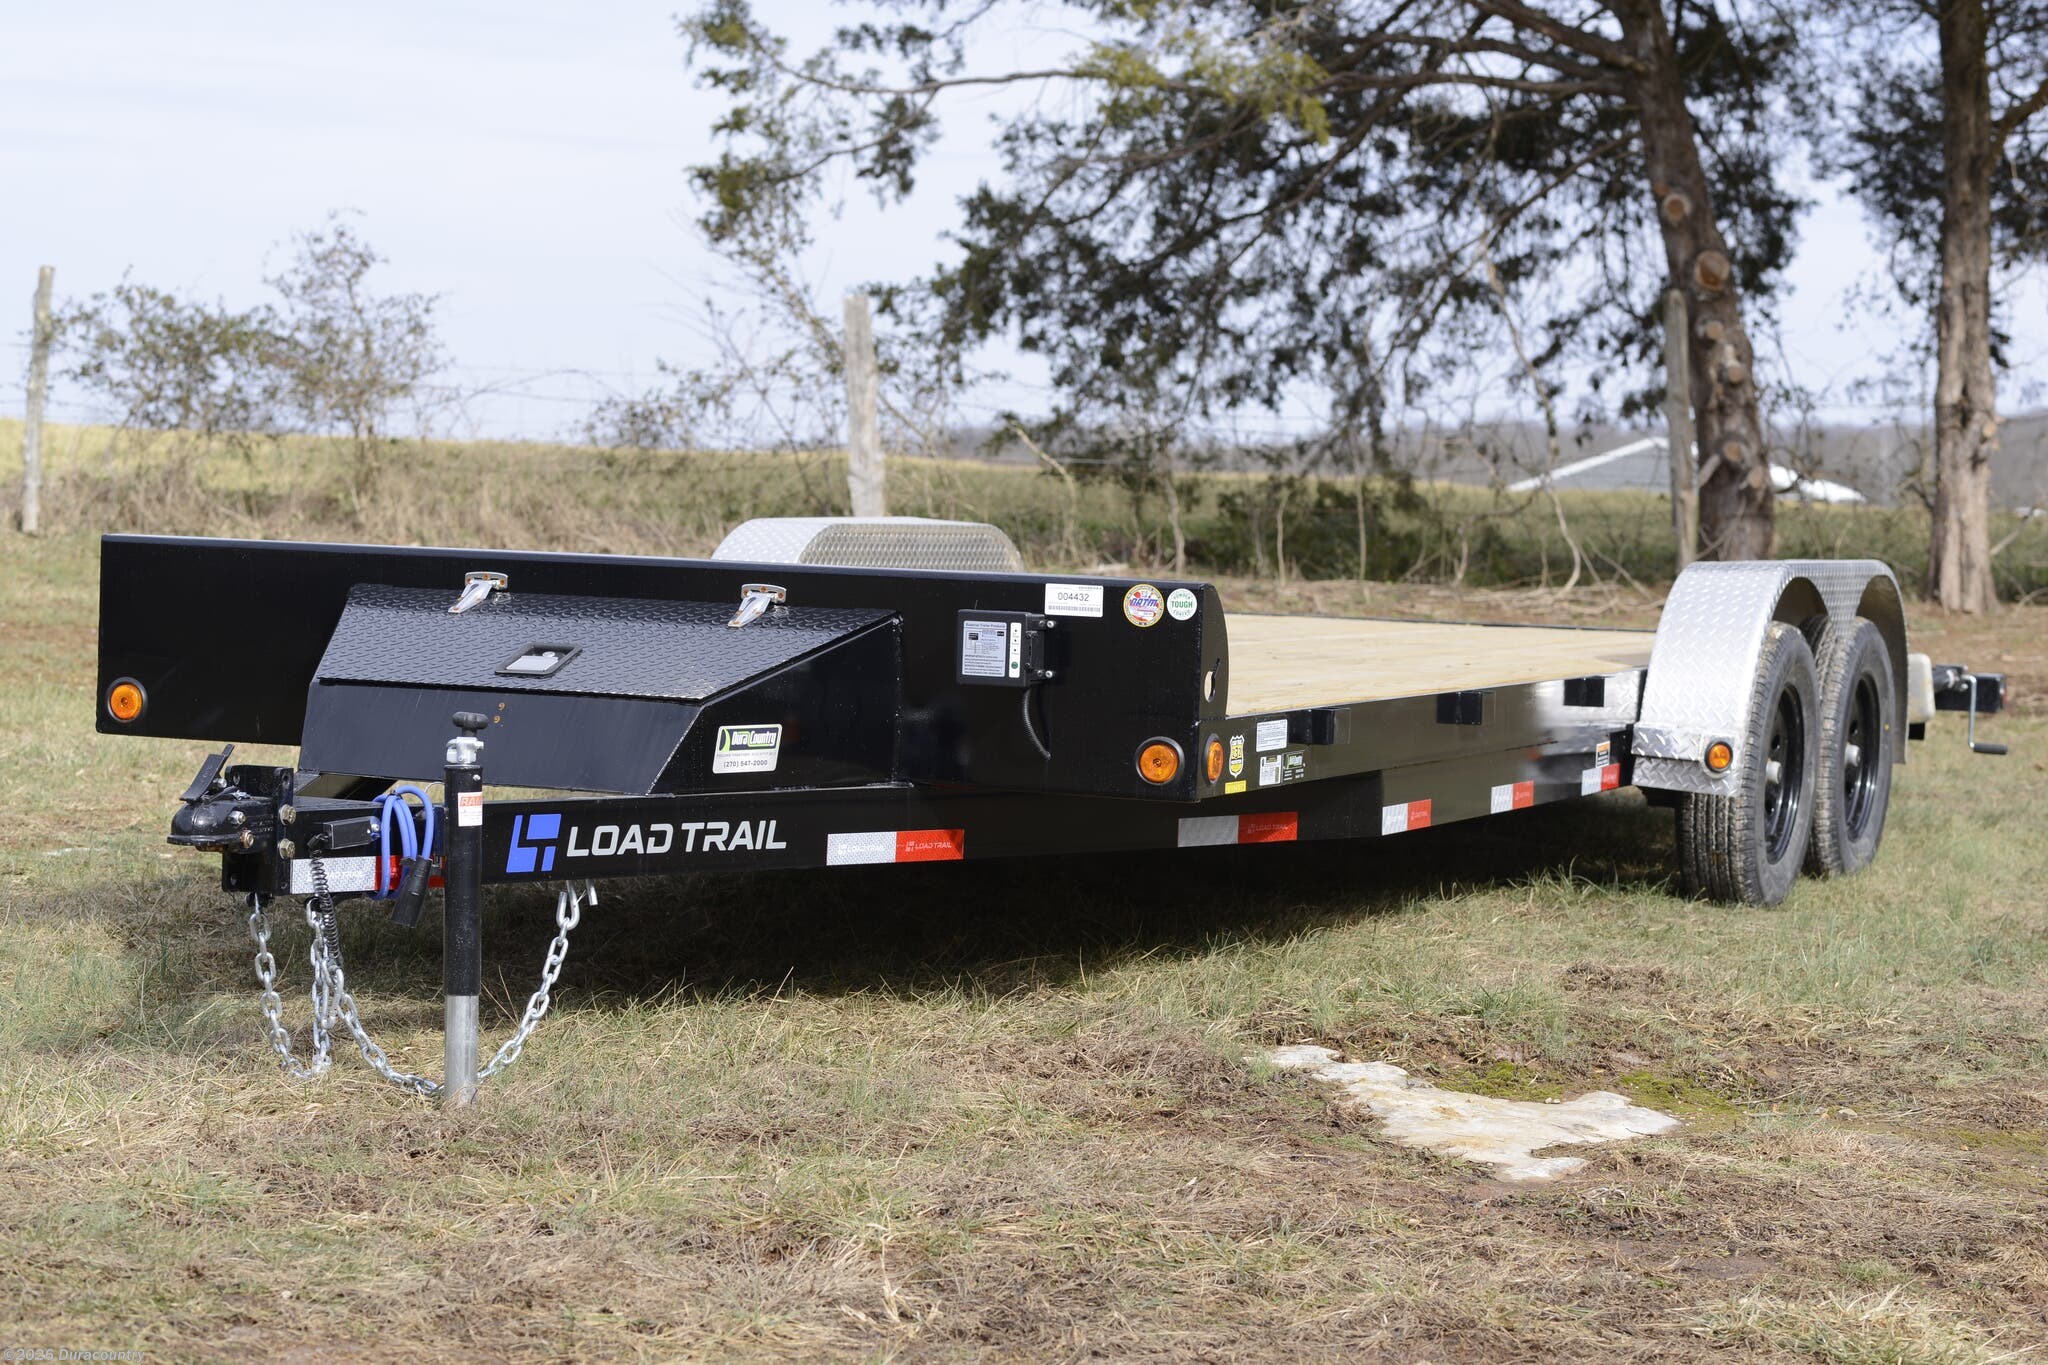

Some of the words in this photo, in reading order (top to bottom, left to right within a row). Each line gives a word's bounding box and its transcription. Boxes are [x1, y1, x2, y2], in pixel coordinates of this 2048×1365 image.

[1057, 592, 1090, 602] 004432
[1170, 600, 1193, 609] TOUGH
[731, 731, 748, 746] Dura
[749, 730, 777, 747] Country
[723, 760, 739, 769] (270)
[740, 759, 768, 767] 547-2000
[566, 823, 674, 857] LOAD
[681, 819, 787, 853] TRAIL
[914, 841, 934, 850] LOAD
[934, 840, 953, 849] TRAIL
